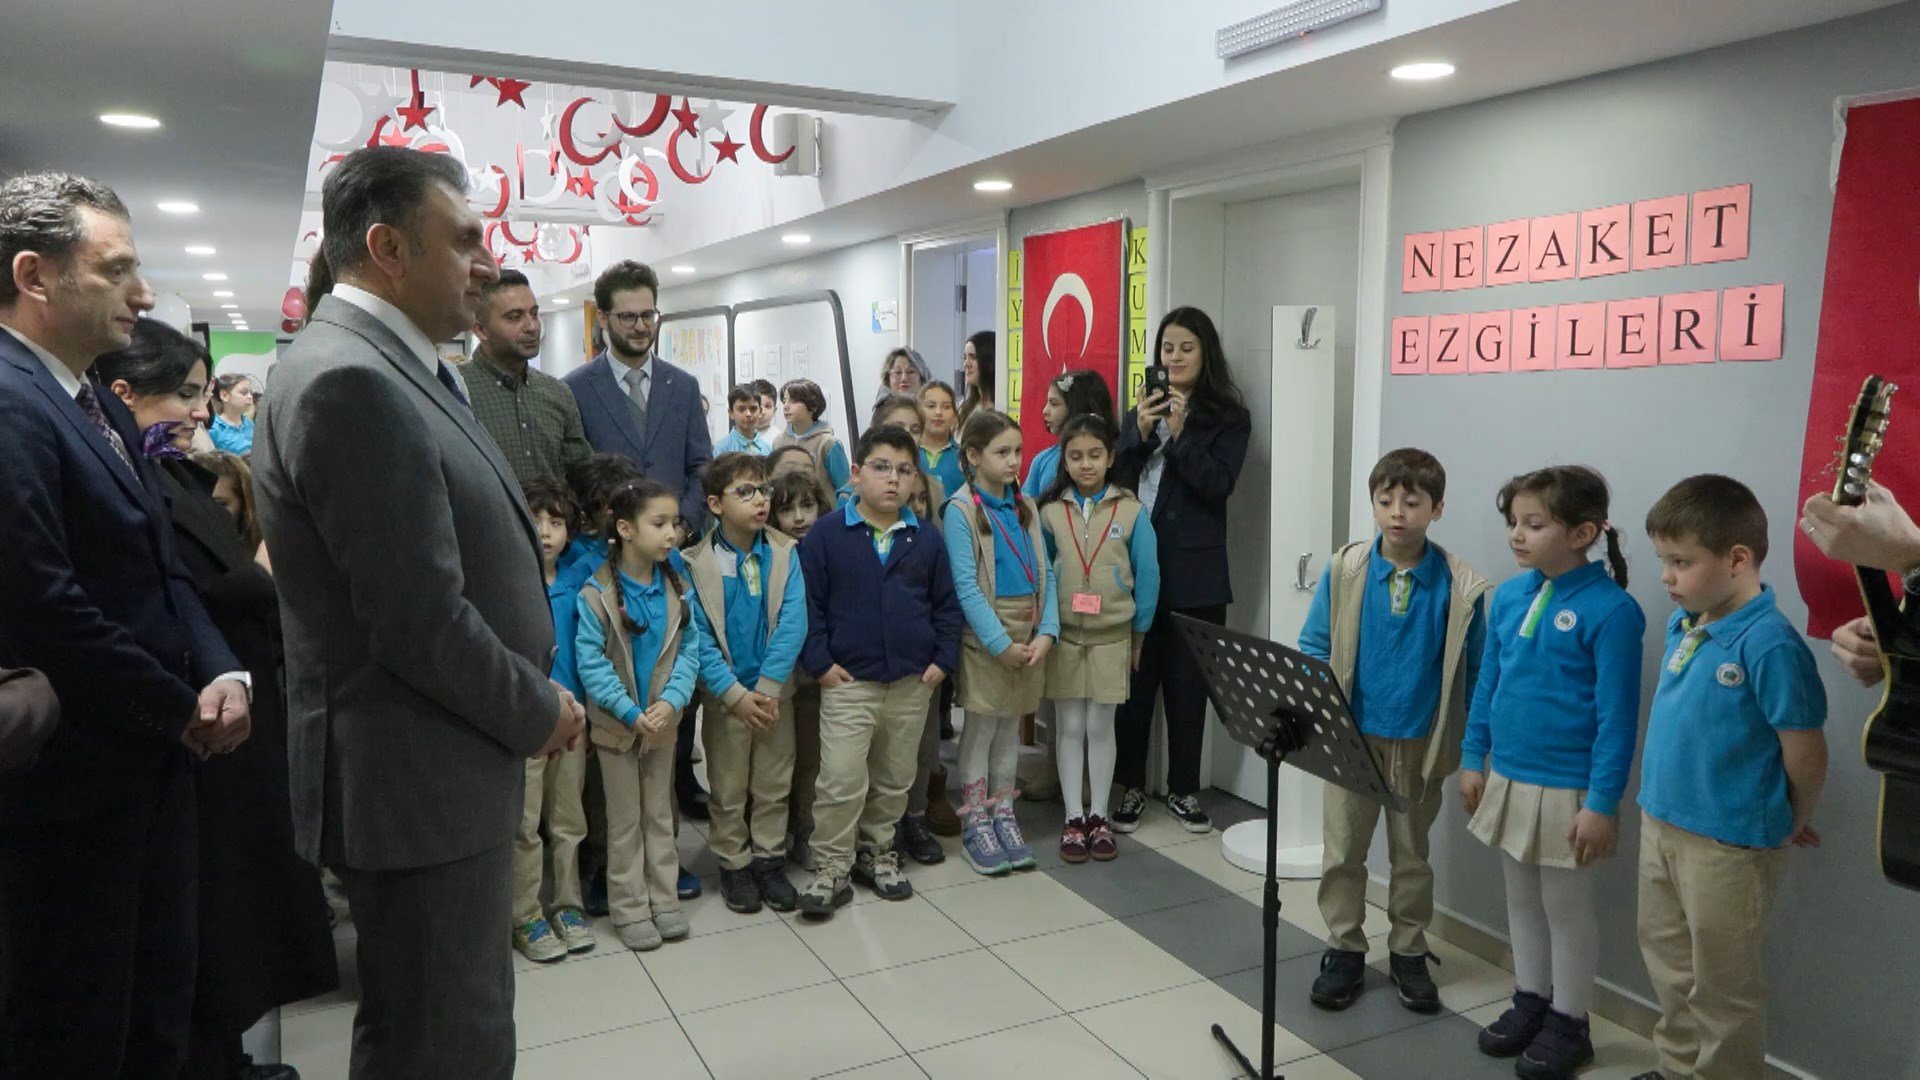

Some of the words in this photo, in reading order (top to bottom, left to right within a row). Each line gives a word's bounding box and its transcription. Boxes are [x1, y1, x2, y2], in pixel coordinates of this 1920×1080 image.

[1411, 203, 1738, 278] NEZAKET
[1012, 253, 1022, 418] İYİL
[1398, 292, 1761, 364] EZGİLERİ
